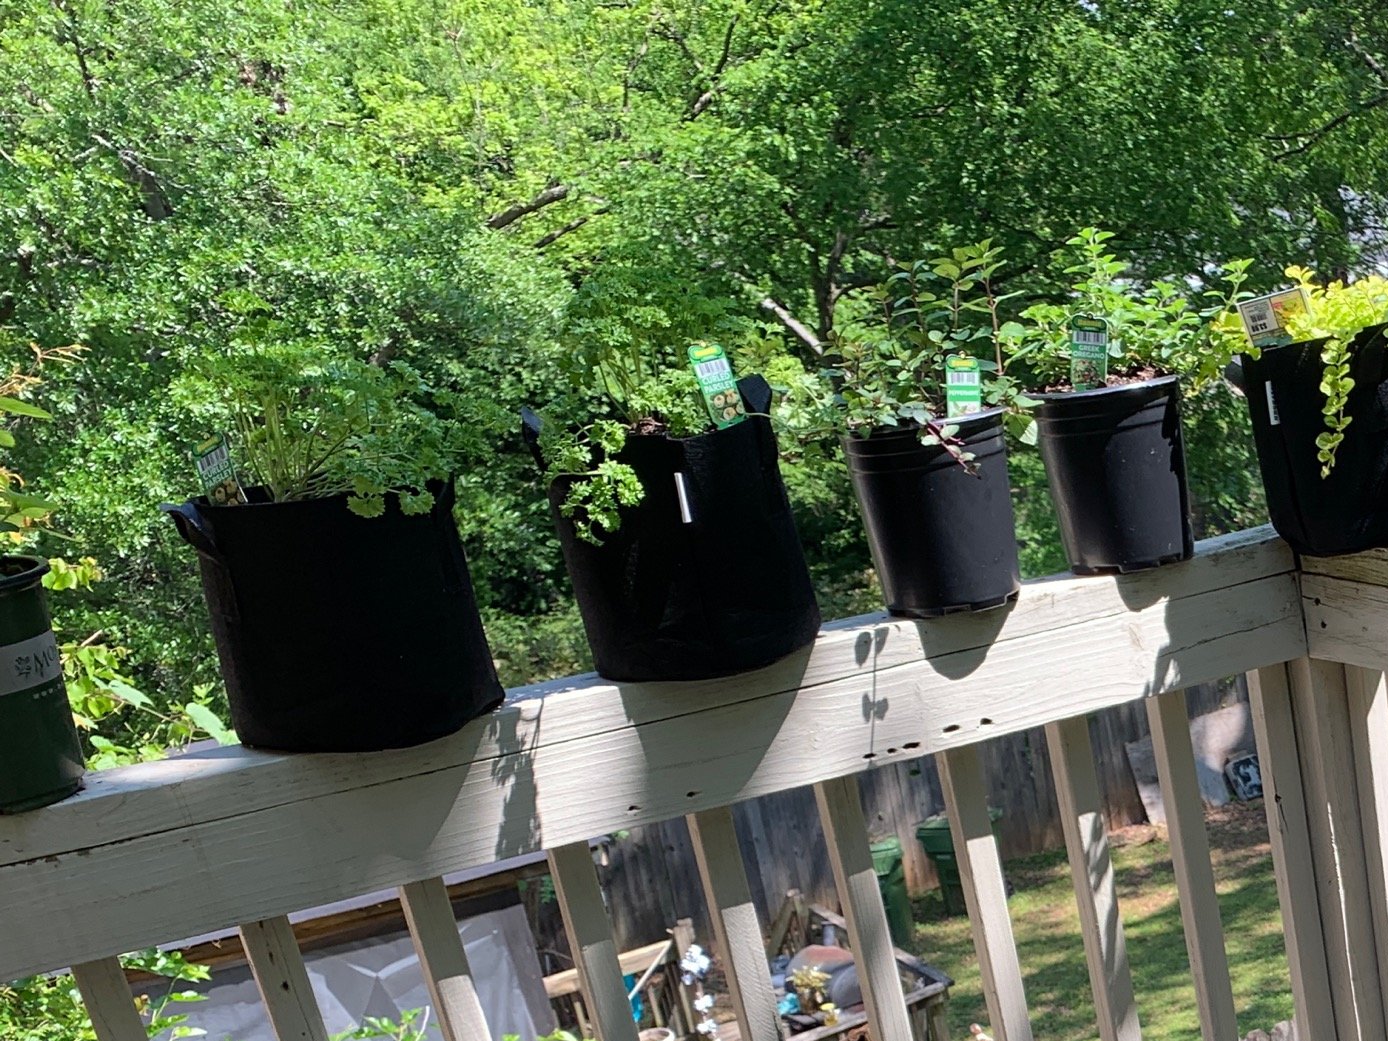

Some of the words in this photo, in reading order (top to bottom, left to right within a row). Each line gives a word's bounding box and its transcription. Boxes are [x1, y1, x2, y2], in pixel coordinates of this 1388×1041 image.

[1072, 351, 1105, 359] OREGANO
[701, 372, 731, 385] CURLED
[703, 380, 734, 393] PARSLEY
[202, 461, 229, 480] CURLED
[204, 468, 232, 489] PARSLEY
